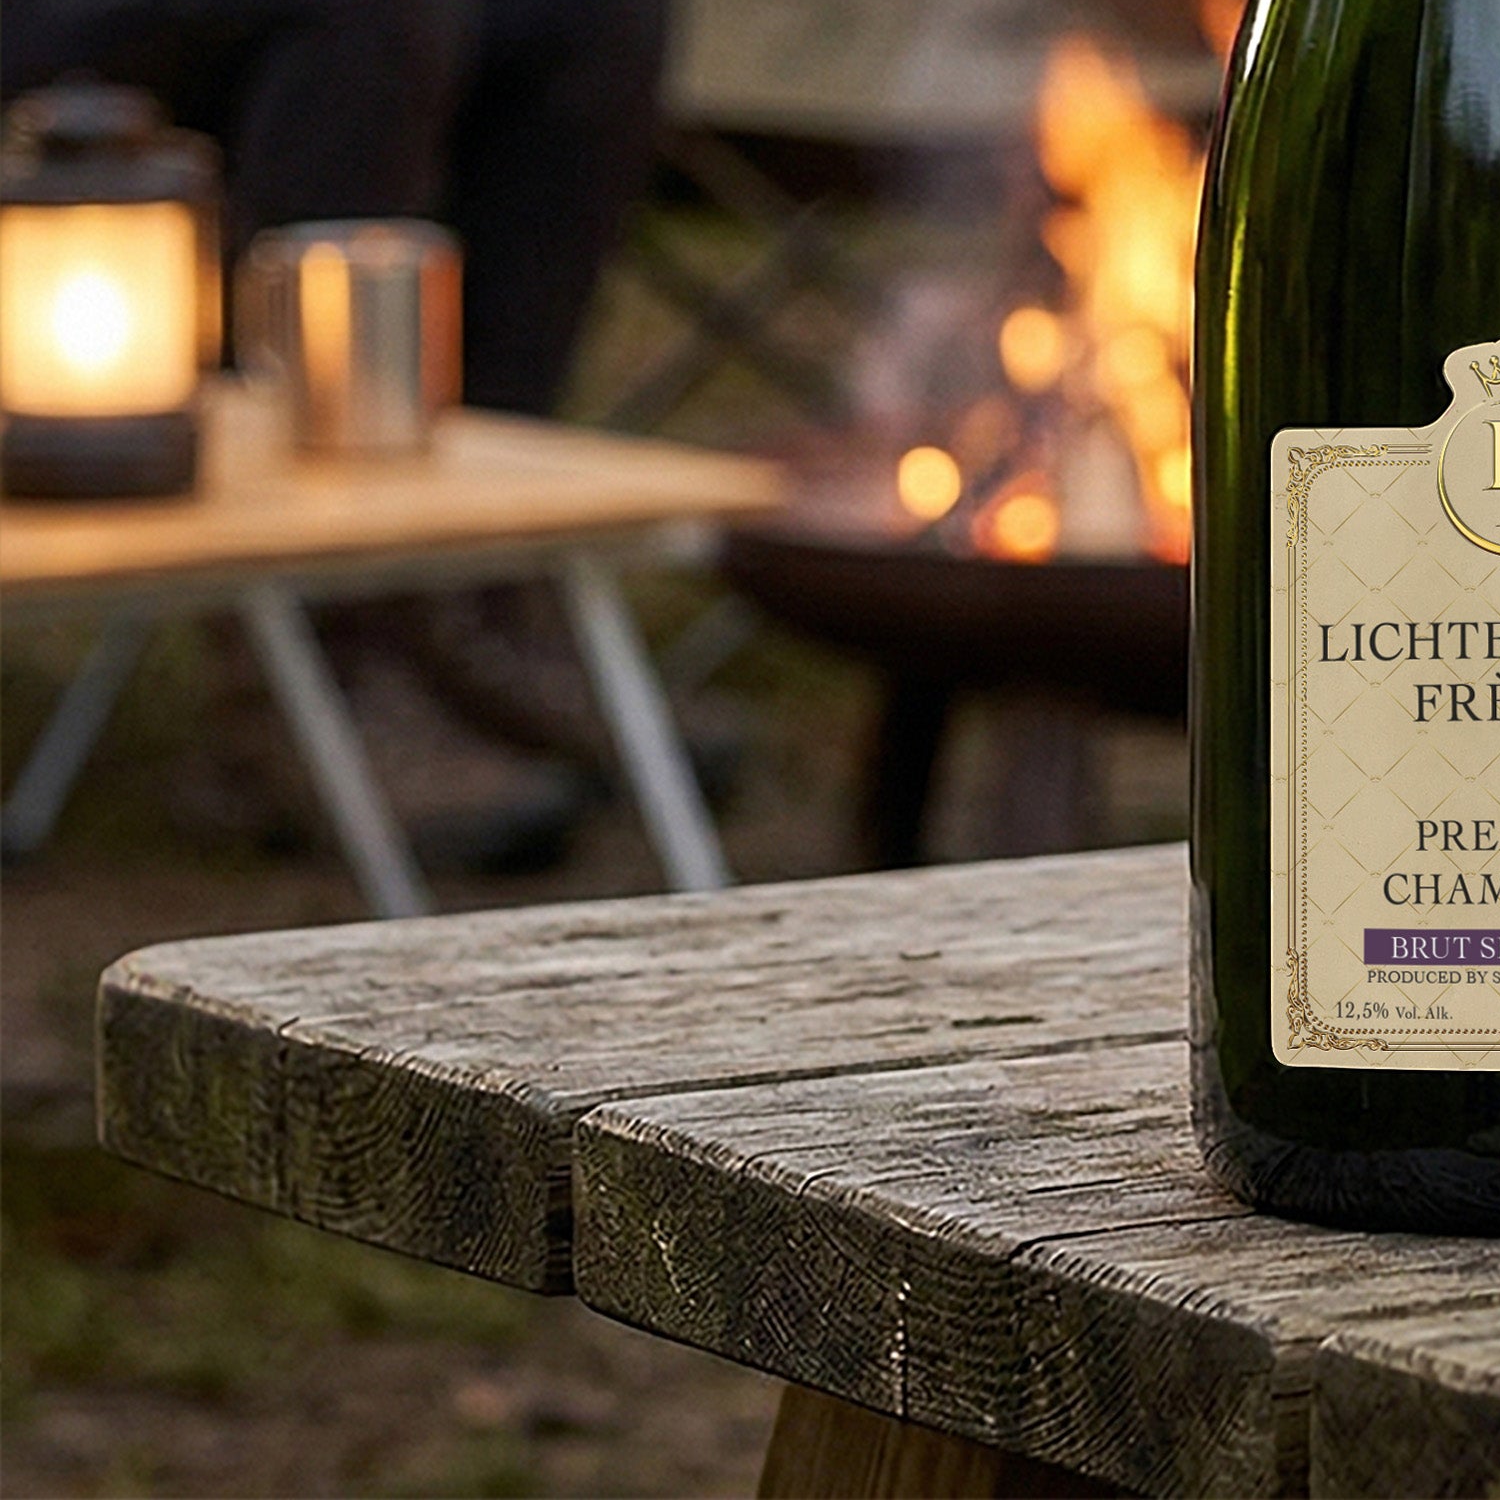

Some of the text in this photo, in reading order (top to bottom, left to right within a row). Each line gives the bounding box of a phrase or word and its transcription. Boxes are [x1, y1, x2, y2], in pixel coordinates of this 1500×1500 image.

[1391, 936, 1471, 960] BRUT
[1367, 970, 1462, 985] PRODUCED
[1466, 971, 1489, 984] BY
[1336, 1001, 1453, 1020] 12,5% Vol. Alk.
